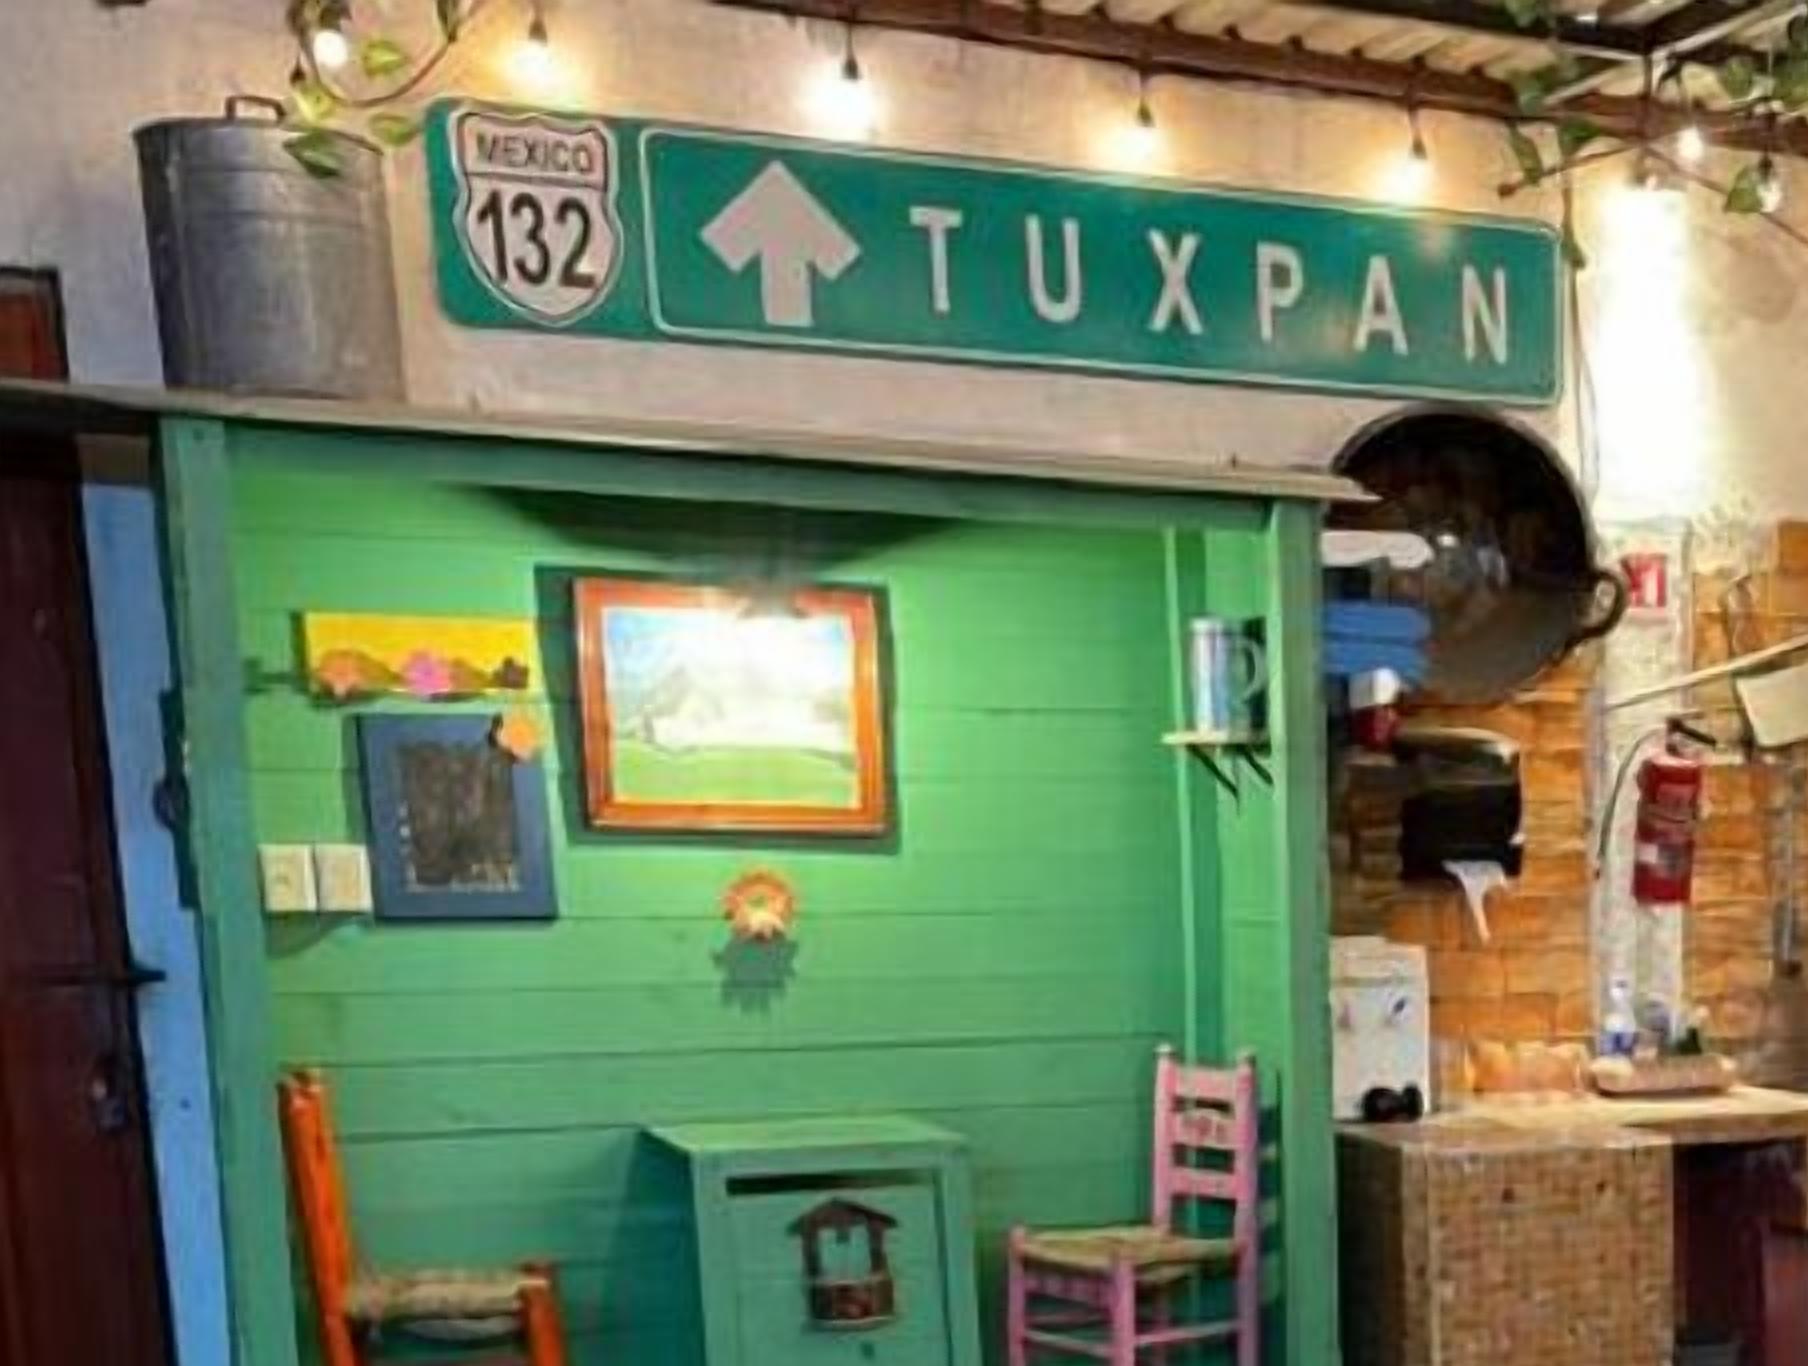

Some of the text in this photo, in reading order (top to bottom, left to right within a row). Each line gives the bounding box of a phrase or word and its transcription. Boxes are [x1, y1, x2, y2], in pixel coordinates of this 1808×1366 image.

[476, 132, 593, 173] MEXICO
[476, 191, 596, 288] 132
[909, 206, 1508, 364] TUXPAN
